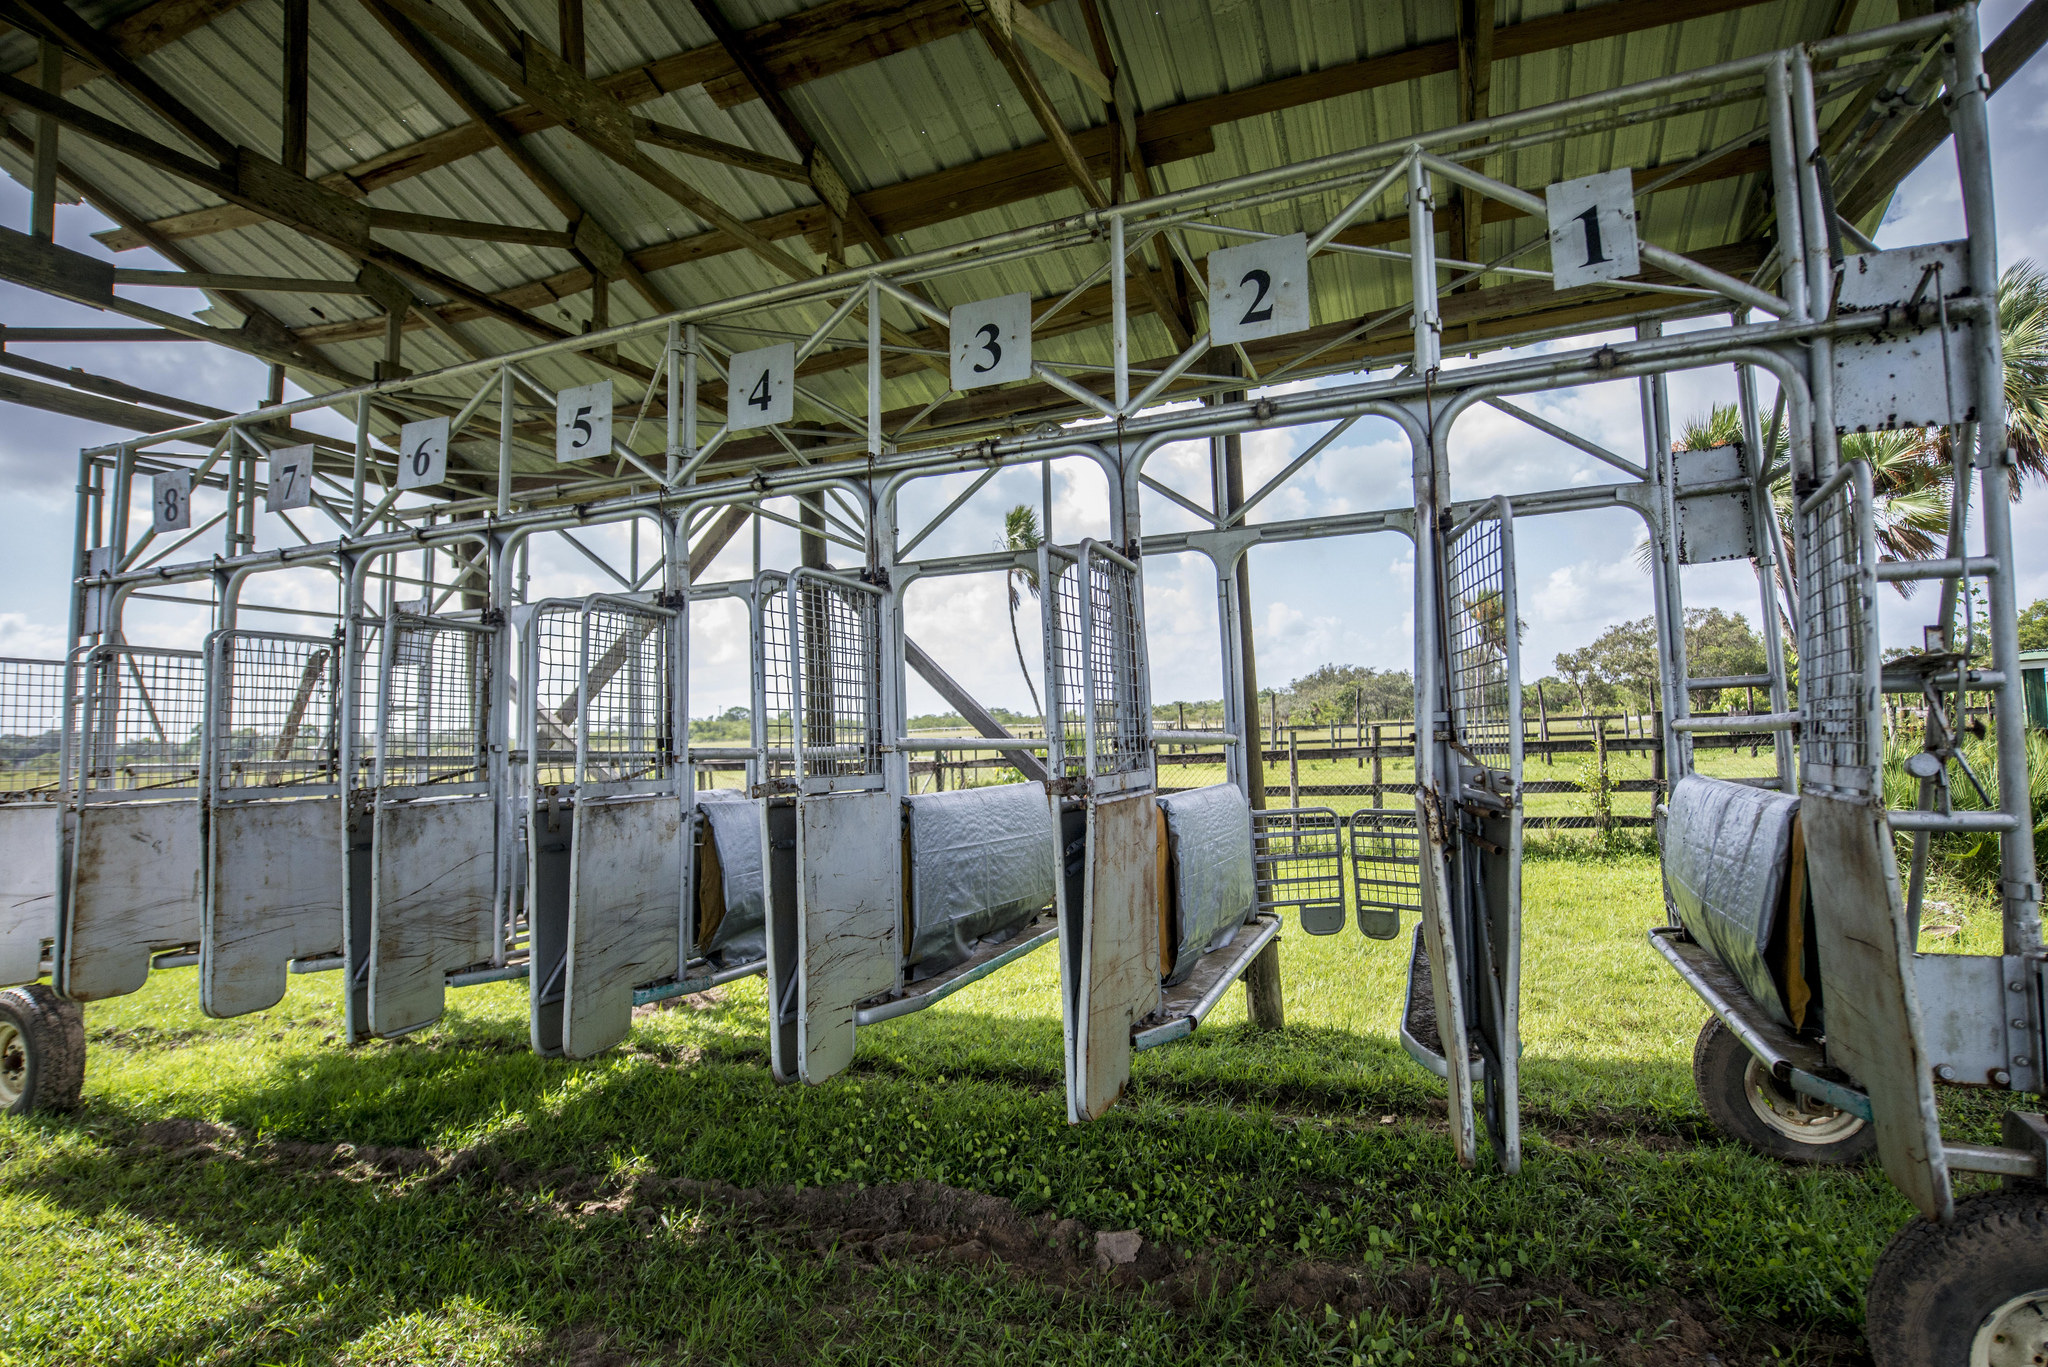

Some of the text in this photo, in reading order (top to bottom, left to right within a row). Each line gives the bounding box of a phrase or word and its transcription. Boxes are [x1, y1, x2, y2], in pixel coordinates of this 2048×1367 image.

[1572, 205, 1613, 267] 1
[1240, 269, 1273, 324] 2
[974, 324, 1001, 372] 3
[748, 369, 771, 411] 4
[573, 406, 592, 447] 5
[413, 438, 432, 476] 6
[282, 465, 298, 499] 7
[164, 488, 178, 521] 8
